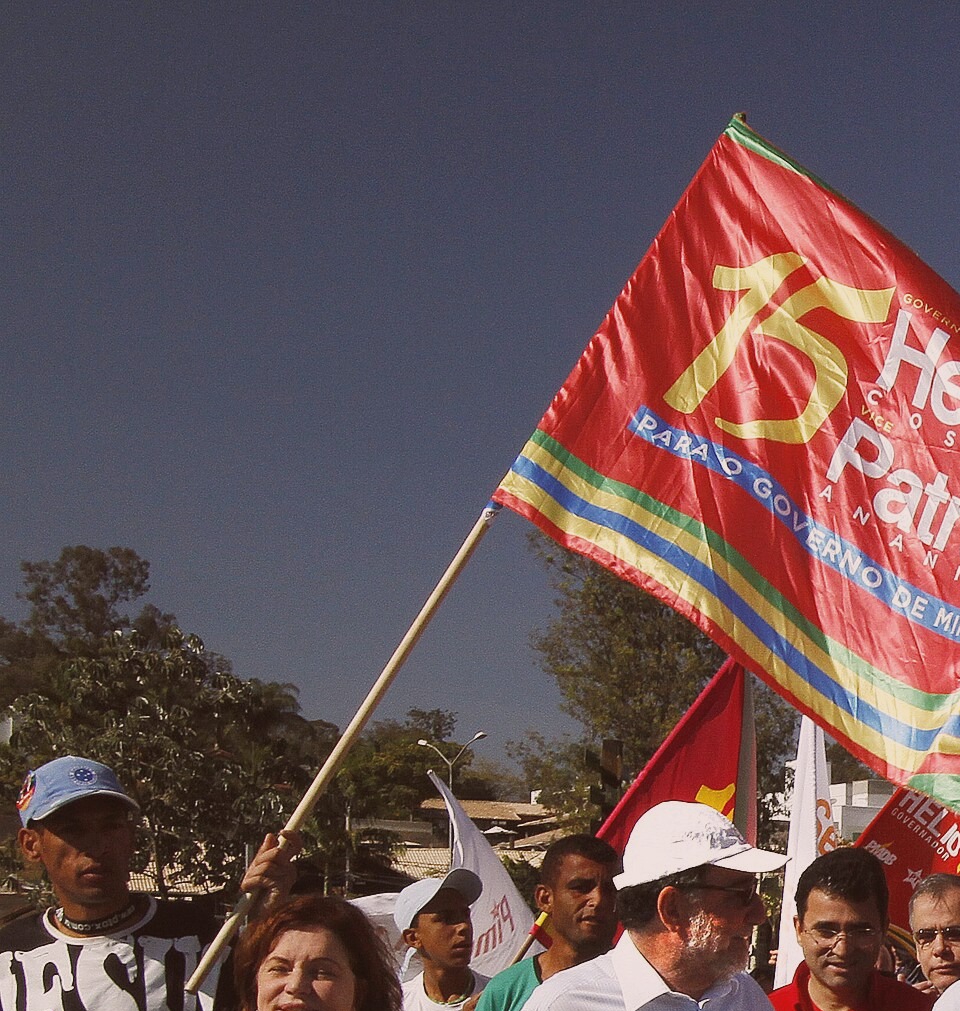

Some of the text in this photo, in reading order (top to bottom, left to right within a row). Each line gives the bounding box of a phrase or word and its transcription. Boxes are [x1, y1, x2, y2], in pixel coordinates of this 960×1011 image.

[663, 252, 896, 444] 15
[860, 404, 894, 433] VICE
[636, 414, 709, 461] PARA
[720, 457, 743, 476] O
[752, 477, 883, 589] GOVERNO
[892, 585, 929, 619] DE
[864, 840, 897, 865] PMDB
[891, 807, 950, 861] GOVERNADOR
